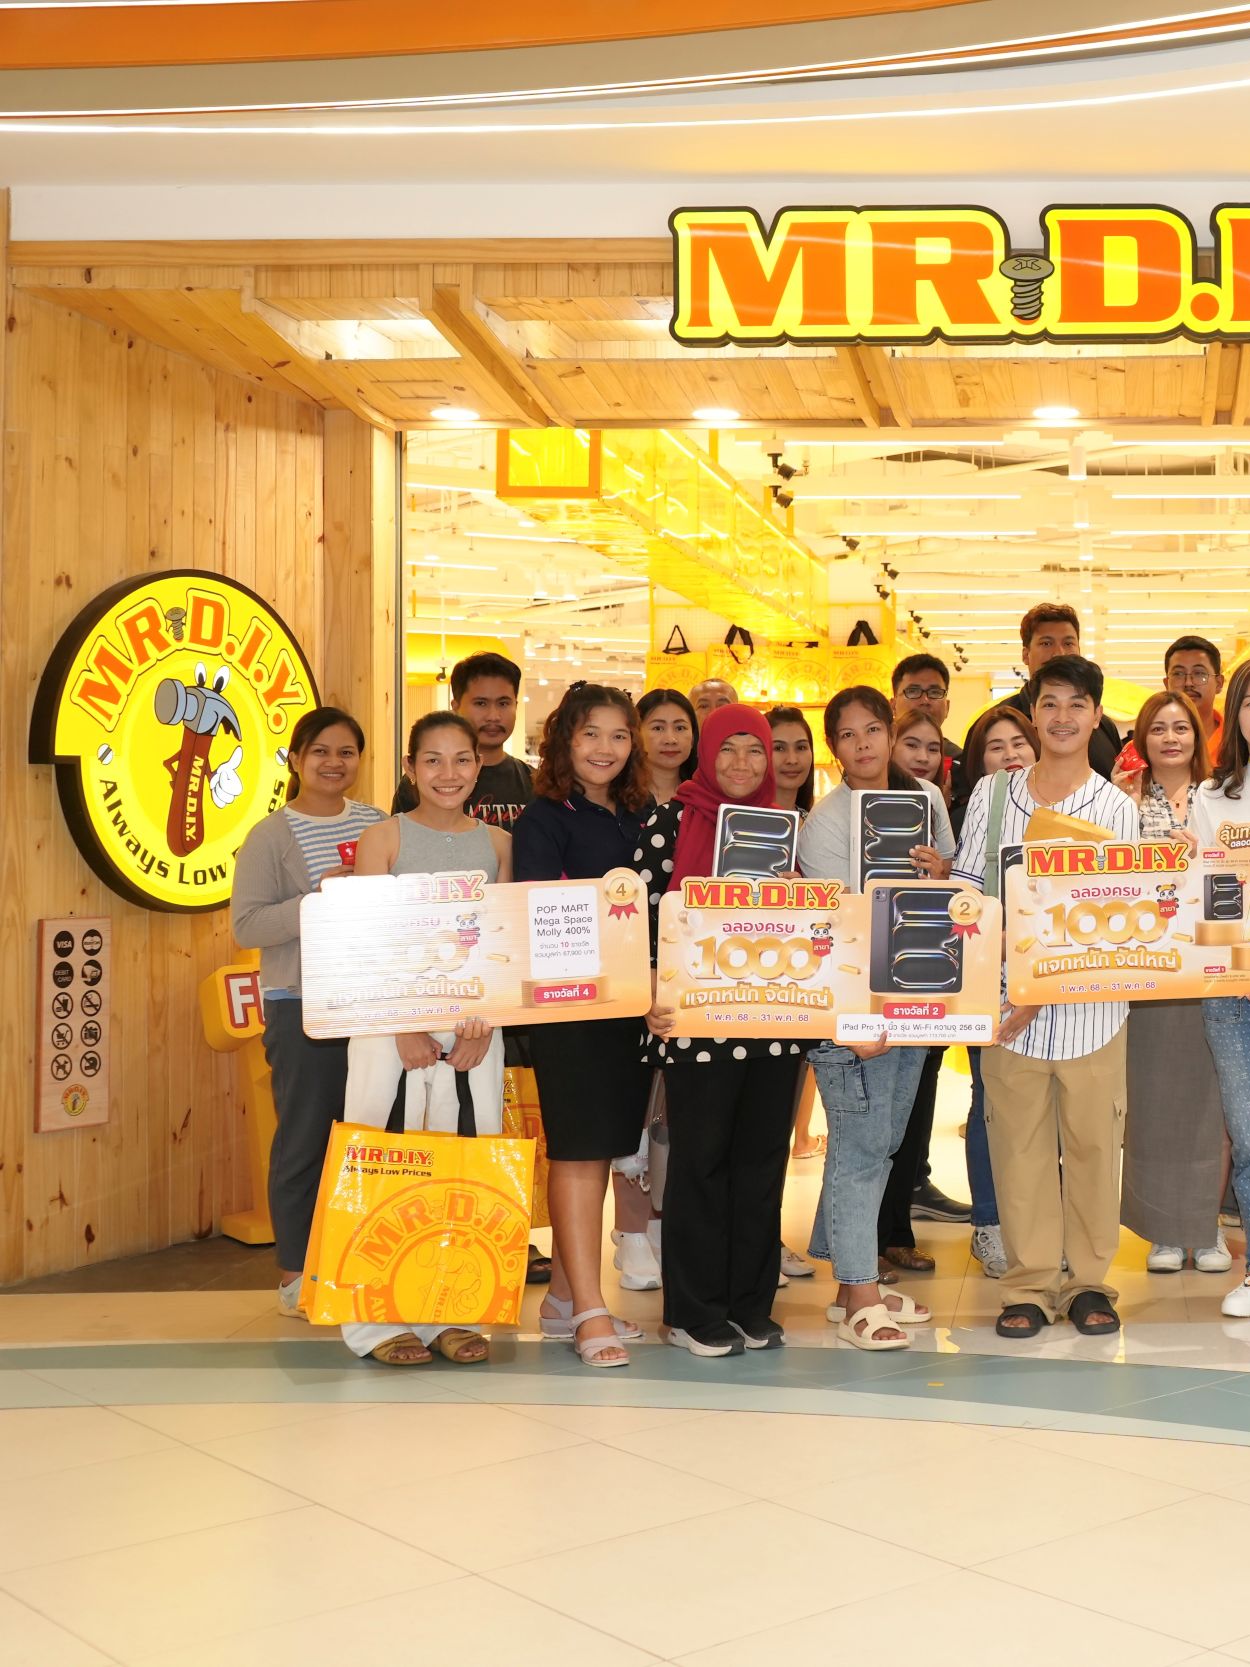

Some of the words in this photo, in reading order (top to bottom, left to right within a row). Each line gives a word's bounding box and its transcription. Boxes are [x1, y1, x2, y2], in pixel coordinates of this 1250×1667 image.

[99, 778, 170, 875] Always
[178, 861, 227, 886] Low
[616, 882, 627, 897] 4
[1070, 886, 1141, 899] ฉลองครบ
[537, 906, 558, 914] POP
[561, 904, 590, 913] MART
[959, 902, 970, 916] 2
[534, 917, 560, 927] Mega
[564, 916, 593, 926] Space
[1044, 900, 1169, 947] 1000
[537, 928, 562, 938] Molly
[565, 927, 591, 935] 400%
[722, 922, 795, 934] ฉลองครบ
[57, 941, 73, 949] VISA
[694, 936, 823, 980] 1000
[1038, 950, 1110, 975] แจกหนัก
[1115, 947, 1177, 970] จัดใหญ่
[1111, 983, 1121, 991] 31
[1145, 981, 1156, 989] 68
[543, 986, 580, 999] รางวัลที่
[583, 988, 590, 996] 4
[685, 984, 759, 1006] แจกหนัก
[765, 984, 829, 1007] จัดใหญ่
[893, 1004, 930, 1015] รางวัลที่
[933, 1007, 939, 1015] 2
[934, 1024, 957, 1034] ความจุ
[402, 1169, 432, 1177] Prices
